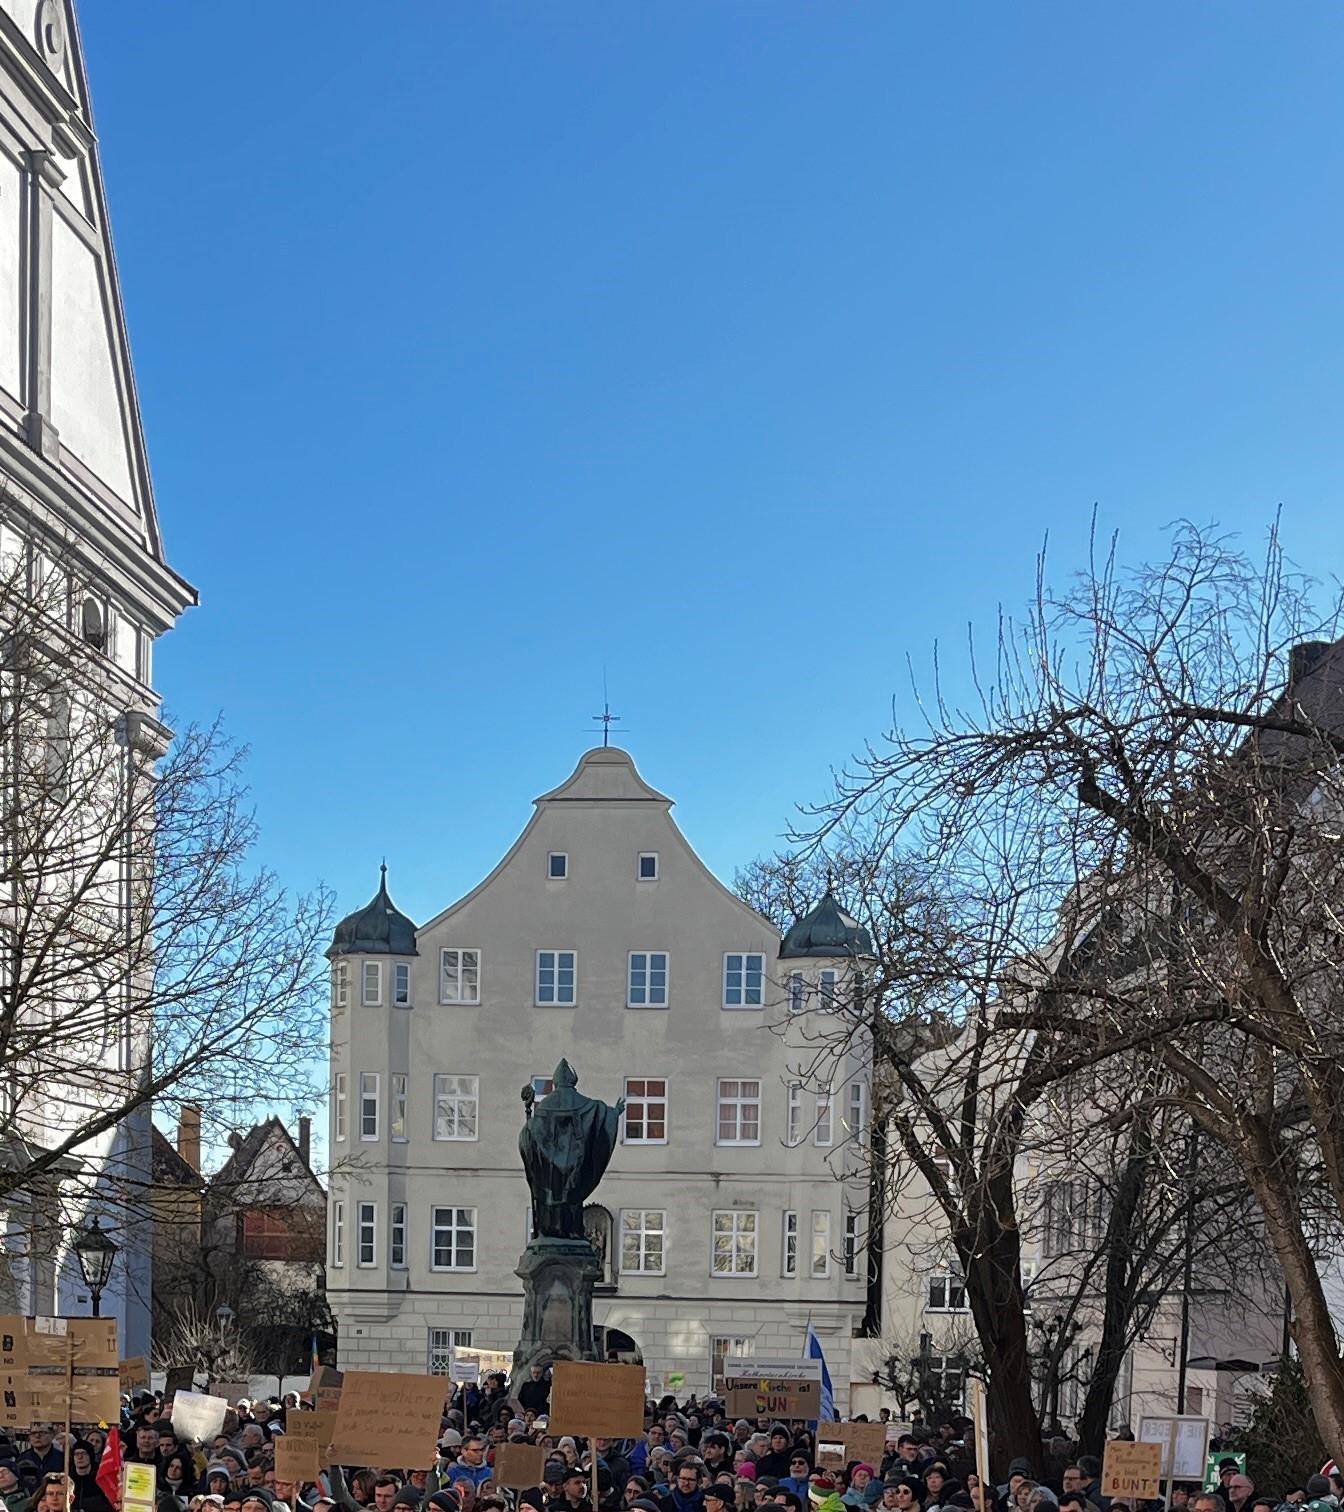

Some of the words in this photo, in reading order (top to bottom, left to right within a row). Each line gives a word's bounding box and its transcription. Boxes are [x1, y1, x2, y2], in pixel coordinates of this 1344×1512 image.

[726, 1378, 758, 1391] Unsere
[760, 1379, 792, 1392] Kirche
[798, 1383, 810, 1392] ist
[755, 1395, 801, 1413] BUNT
[1112, 1478, 1150, 1490] BUNT
